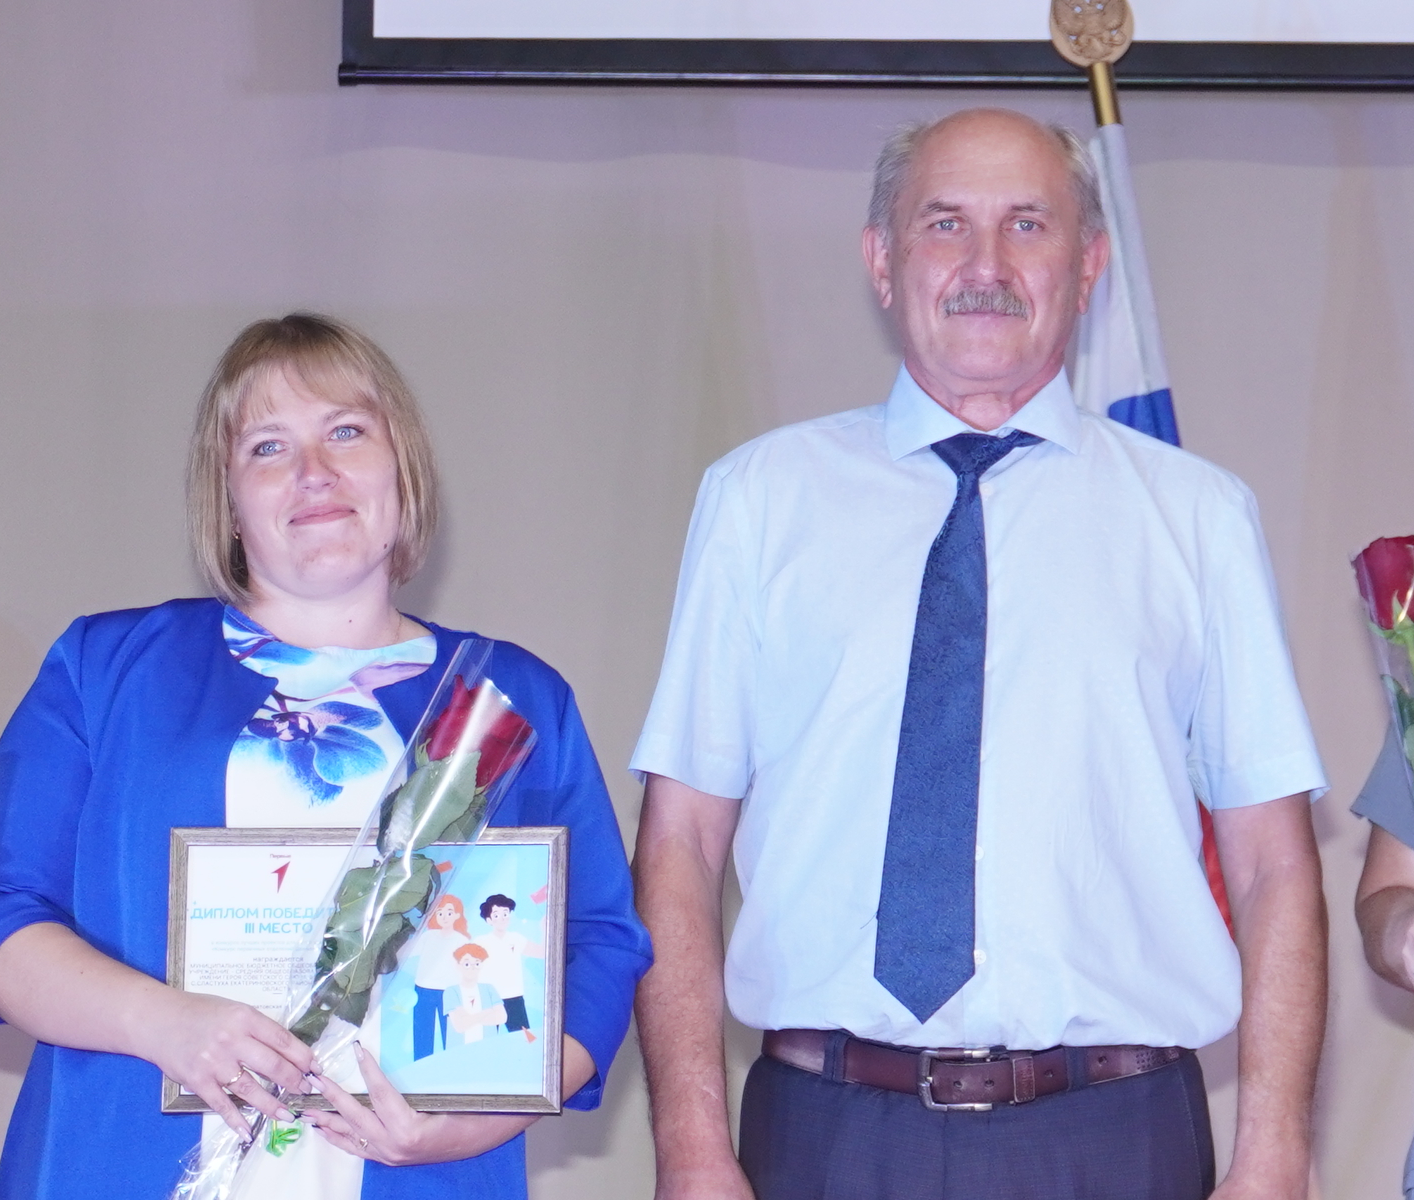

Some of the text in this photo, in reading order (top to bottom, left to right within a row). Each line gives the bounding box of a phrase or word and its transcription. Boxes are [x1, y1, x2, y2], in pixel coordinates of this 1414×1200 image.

[190, 907, 334, 920] ДИПЛОМ ПОБЕДИТ
[244, 922, 313, 934] III МЕСТО
